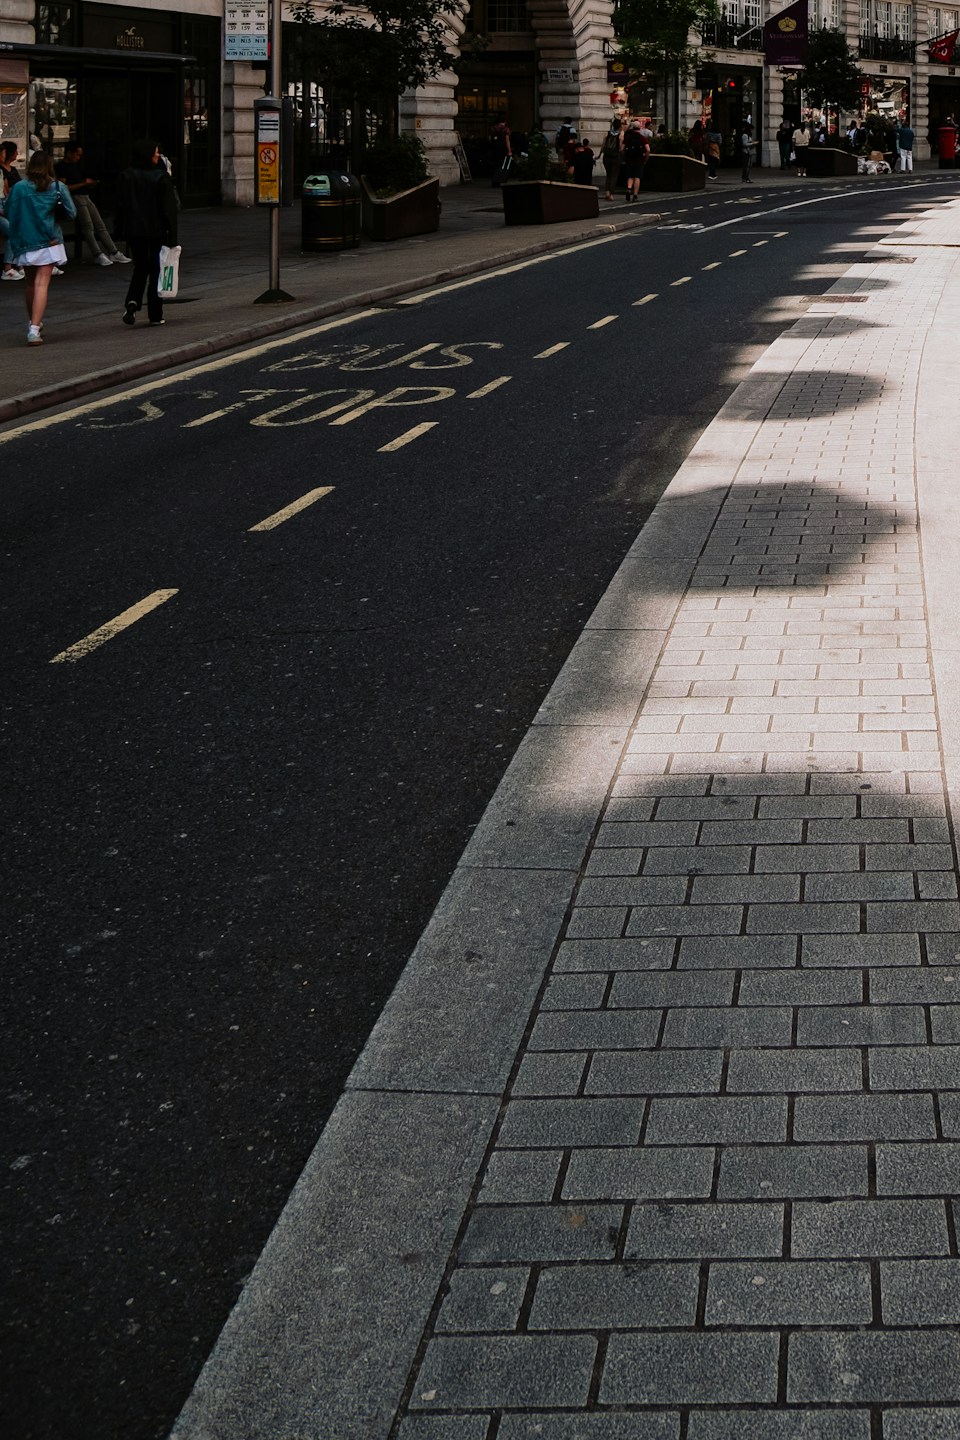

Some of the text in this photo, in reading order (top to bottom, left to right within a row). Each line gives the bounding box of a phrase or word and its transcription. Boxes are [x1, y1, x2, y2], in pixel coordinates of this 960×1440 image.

[116, 35, 145, 48] HOLLISTER
[258, 341, 506, 373] BUS
[74, 386, 457, 429] STOP
